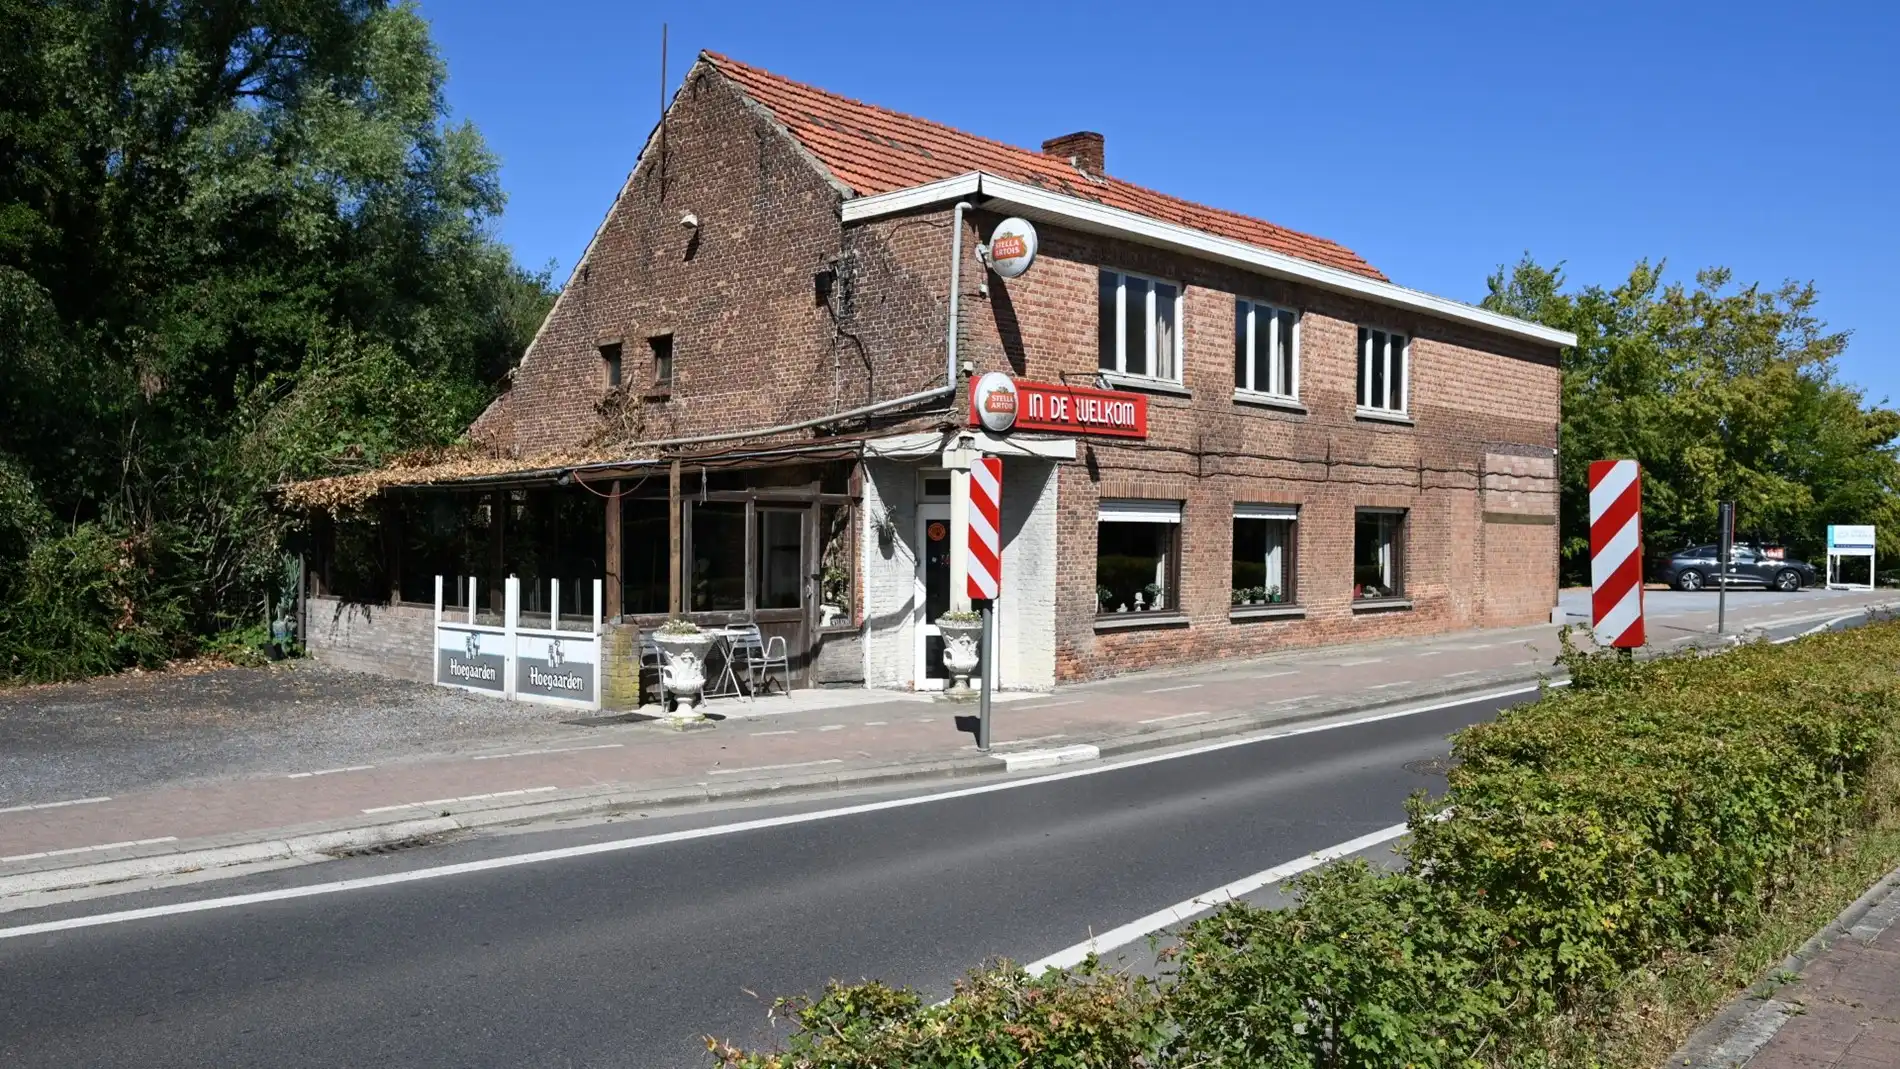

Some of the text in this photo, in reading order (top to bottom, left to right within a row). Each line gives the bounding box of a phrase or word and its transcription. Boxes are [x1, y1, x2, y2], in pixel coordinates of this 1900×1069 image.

[1028, 393, 1136, 426] IN DE WELKOM
[450, 658, 496, 681] Hoegaarden
[529, 667, 584, 691] Hoegaarden
